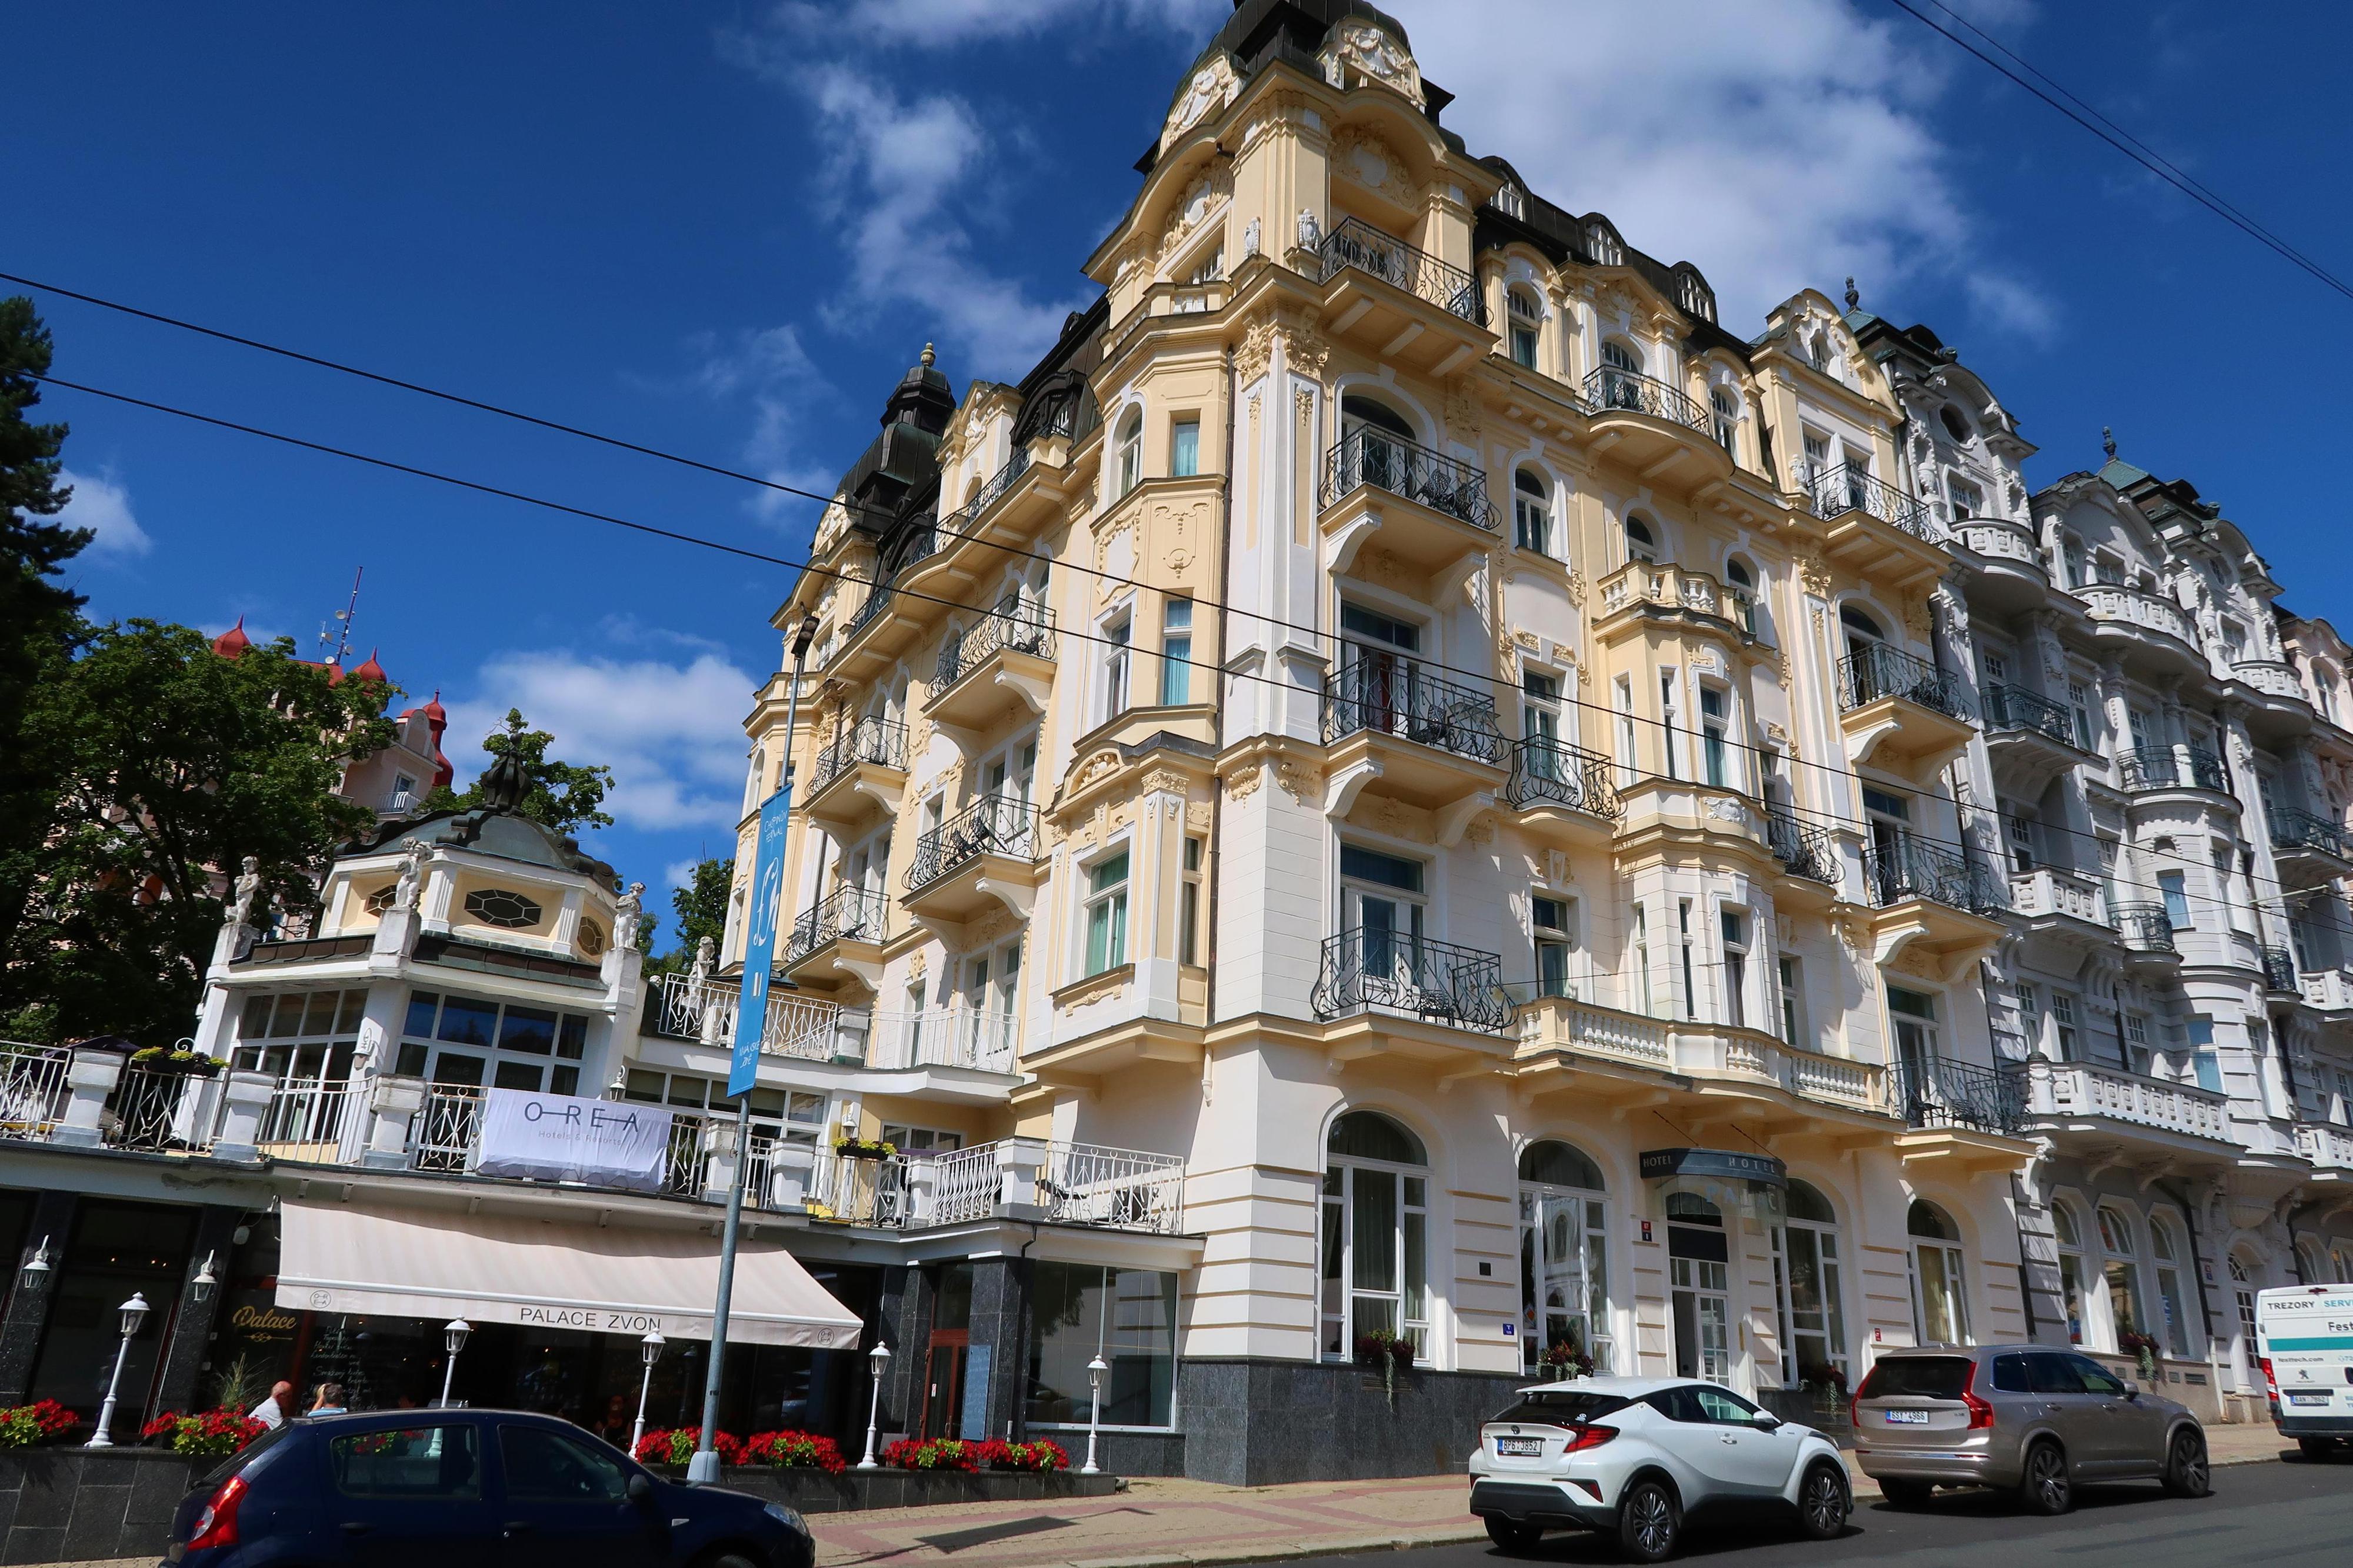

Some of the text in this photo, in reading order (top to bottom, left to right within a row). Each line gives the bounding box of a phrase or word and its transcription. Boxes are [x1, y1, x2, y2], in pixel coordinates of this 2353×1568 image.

[538, 1130, 571, 1140] Hotels
[585, 1135, 622, 1146] Resorts
[1643, 1155, 1775, 1173] HOTEL HOTEL
[2267, 1300, 2315, 1310] TREZORY
[232, 1306, 297, 1329] Palace
[520, 1307, 661, 1332] PALACE ZVON
[1504, 1440, 1516, 1450] 8P6
